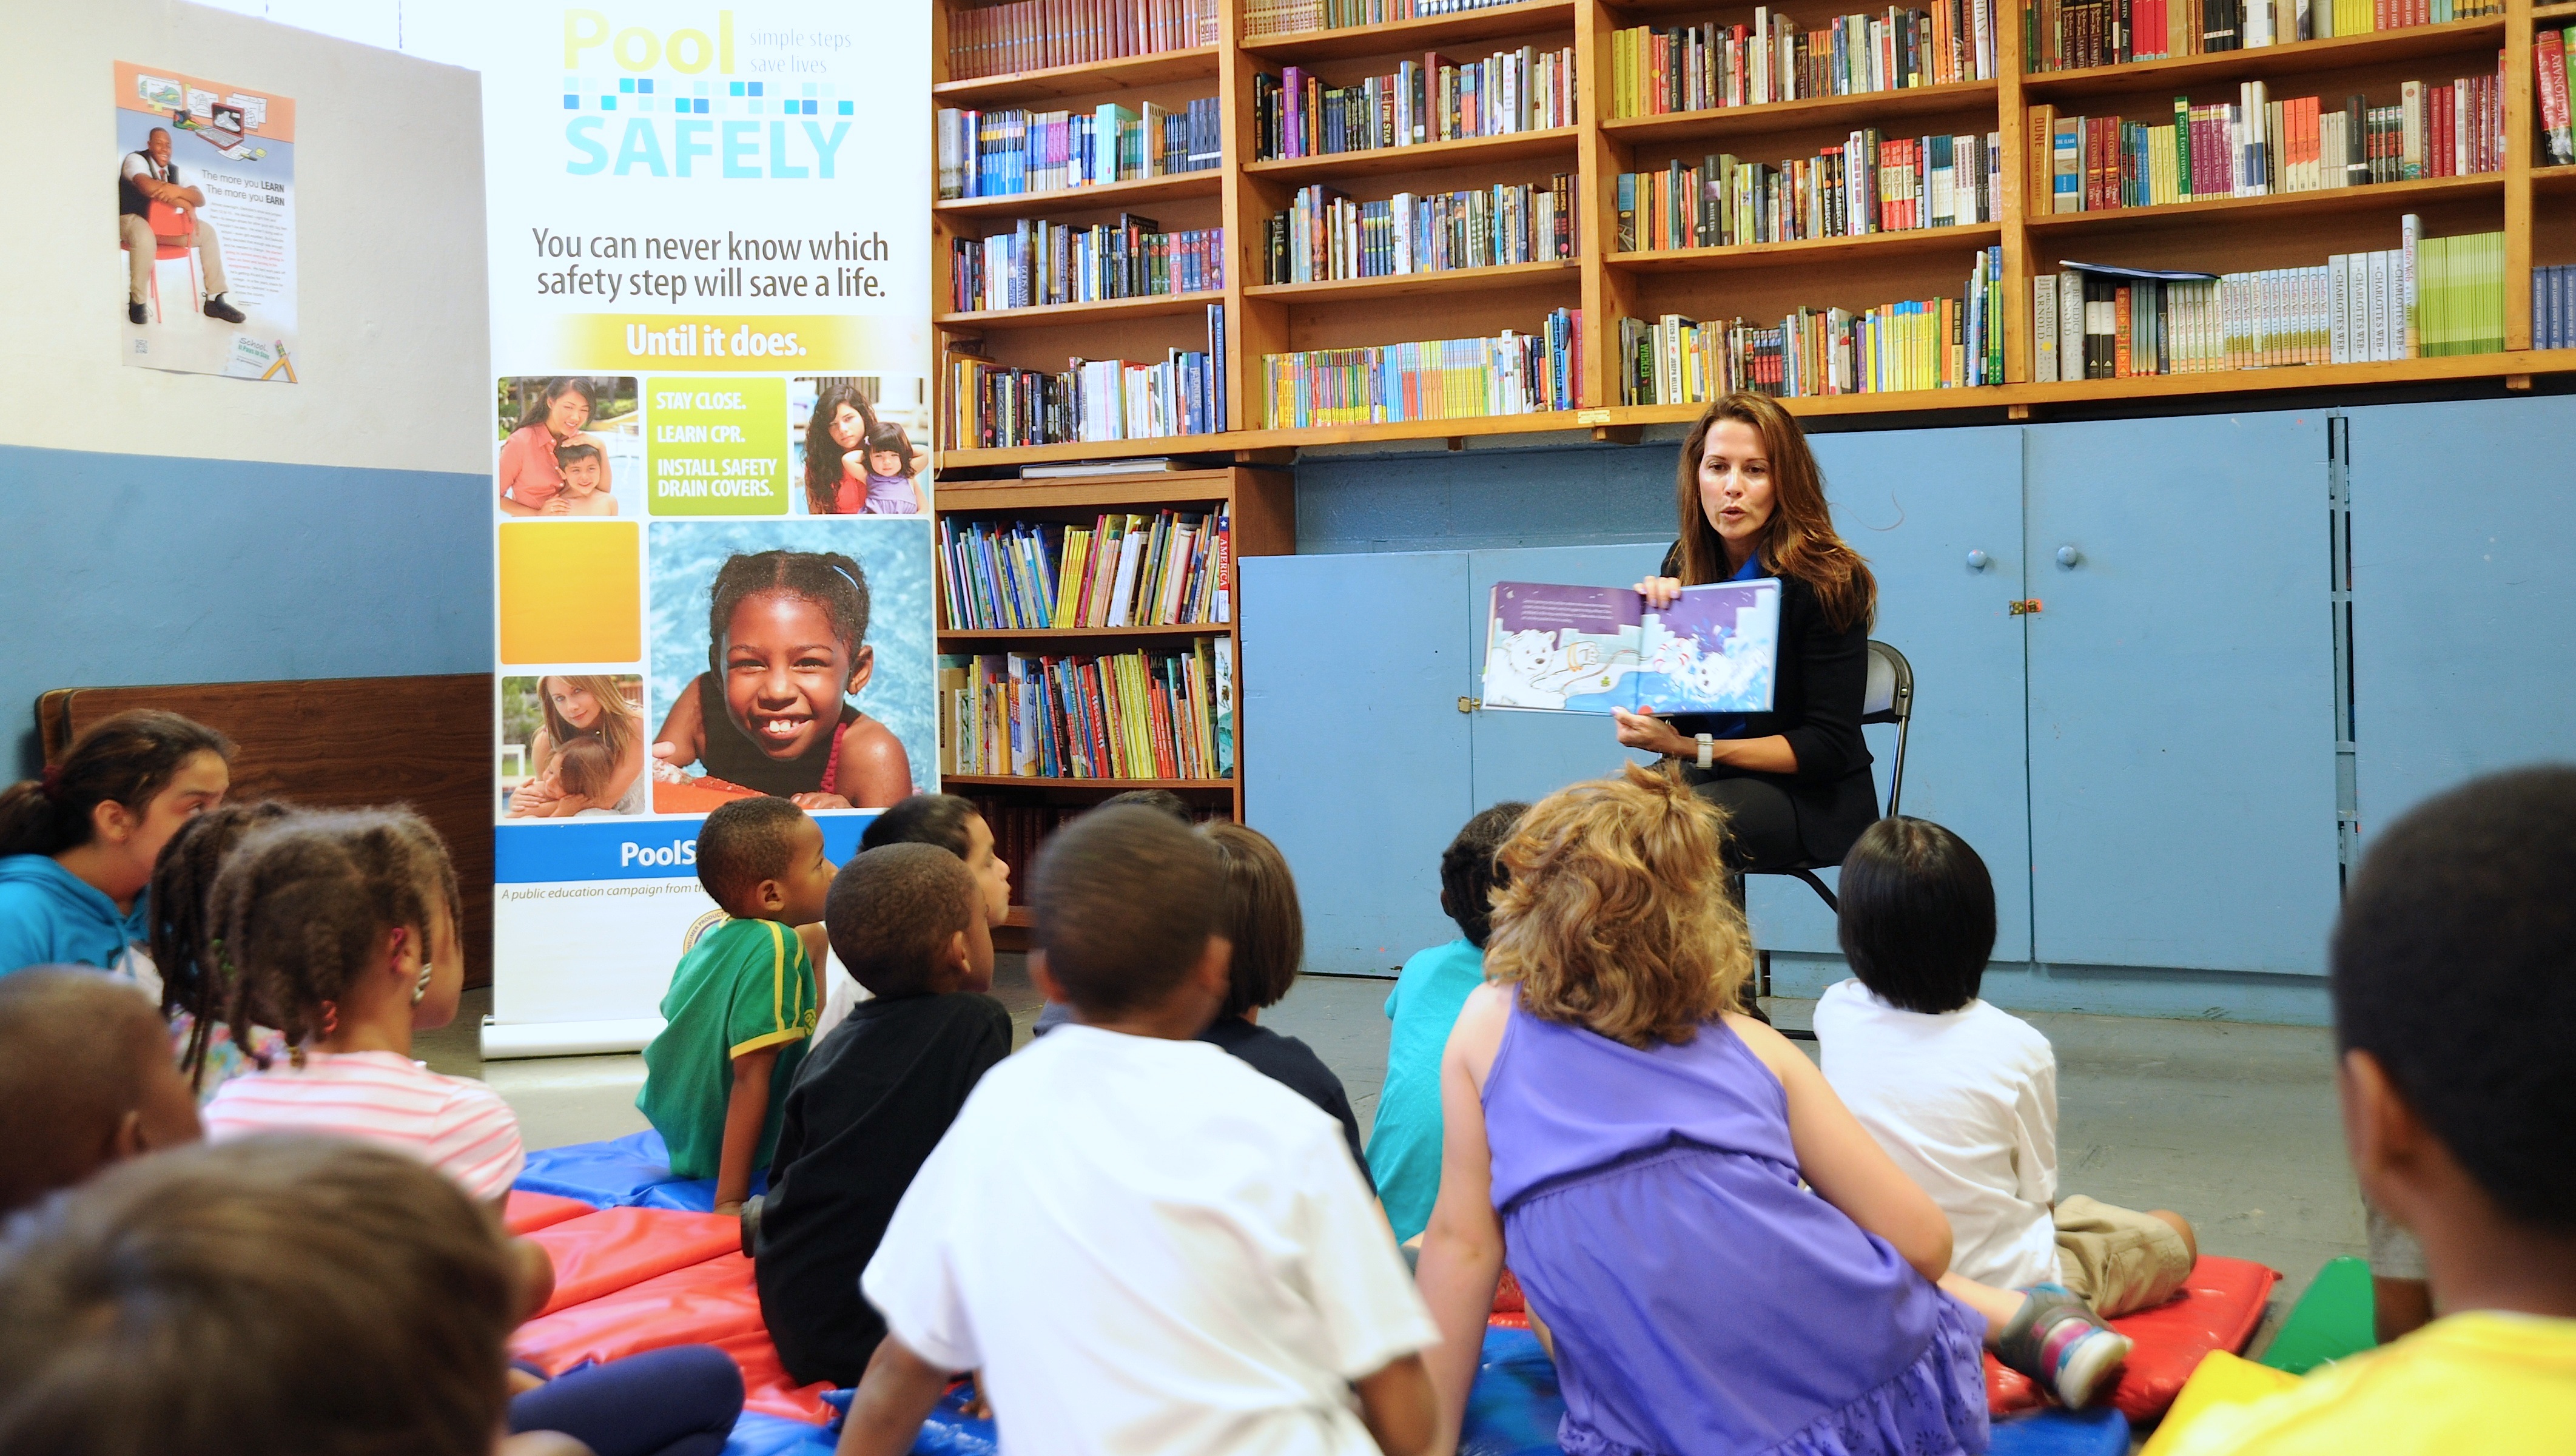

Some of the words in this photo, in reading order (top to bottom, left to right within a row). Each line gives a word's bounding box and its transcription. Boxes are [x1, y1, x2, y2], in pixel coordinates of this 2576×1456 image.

[563, 8, 735, 75] Pool
[750, 28, 805, 50] simple
[809, 30, 852, 49] steps
[750, 57, 785, 73] save
[791, 55, 827, 73] lives
[2539, 61, 2553, 121] STUDENT'S
[2551, 54, 2568, 124] DICTIONARY
[565, 115, 853, 179] SAFELY
[2035, 118, 2044, 147] DUNE
[202, 169, 218, 180] The
[220, 175, 241, 184] more
[261, 181, 284, 192] LEARN
[206, 184, 222, 195] The
[225, 189, 246, 199] more
[266, 195, 284, 206] EARN
[532, 227, 582, 258] You
[590, 234, 636, 258] can
[645, 236, 721, 260] never
[728, 231, 801, 261] know
[809, 232, 889, 261] which
[2404, 228, 2413, 264] Charlotte's
[537, 265, 622, 303] safety
[630, 269, 687, 305] step
[695, 268, 742, 297] will
[750, 274, 807, 297] save
[815, 276, 829, 297] a
[838, 268, 886, 297] life.
[627, 323, 697, 357] Until
[703, 323, 725, 356] it
[731, 323, 805, 357] does.
[1640, 344, 1649, 377] WICKED
[656, 392, 693, 410] STAY
[695, 392, 745, 410] CLOSE.
[1190, 368, 1200, 408] BEYONDERS
[657, 425, 707, 443] LEARN
[710, 425, 745, 443] CPR.
[657, 459, 719, 476] INSTALL
[722, 457, 777, 476] SAFETY
[658, 479, 707, 497] DRAIN
[711, 478, 774, 497] COVERS.
[1219, 539, 1228, 586] AMERICA
[621, 841, 697, 868] PoolS
[511, 888, 546, 901] public
[548, 886, 605, 898] education
[607, 886, 662, 899] campaign
[665, 884, 691, 894] from
[693, 883, 704, 893] th
[687, 926, 698, 950] NSUMER
